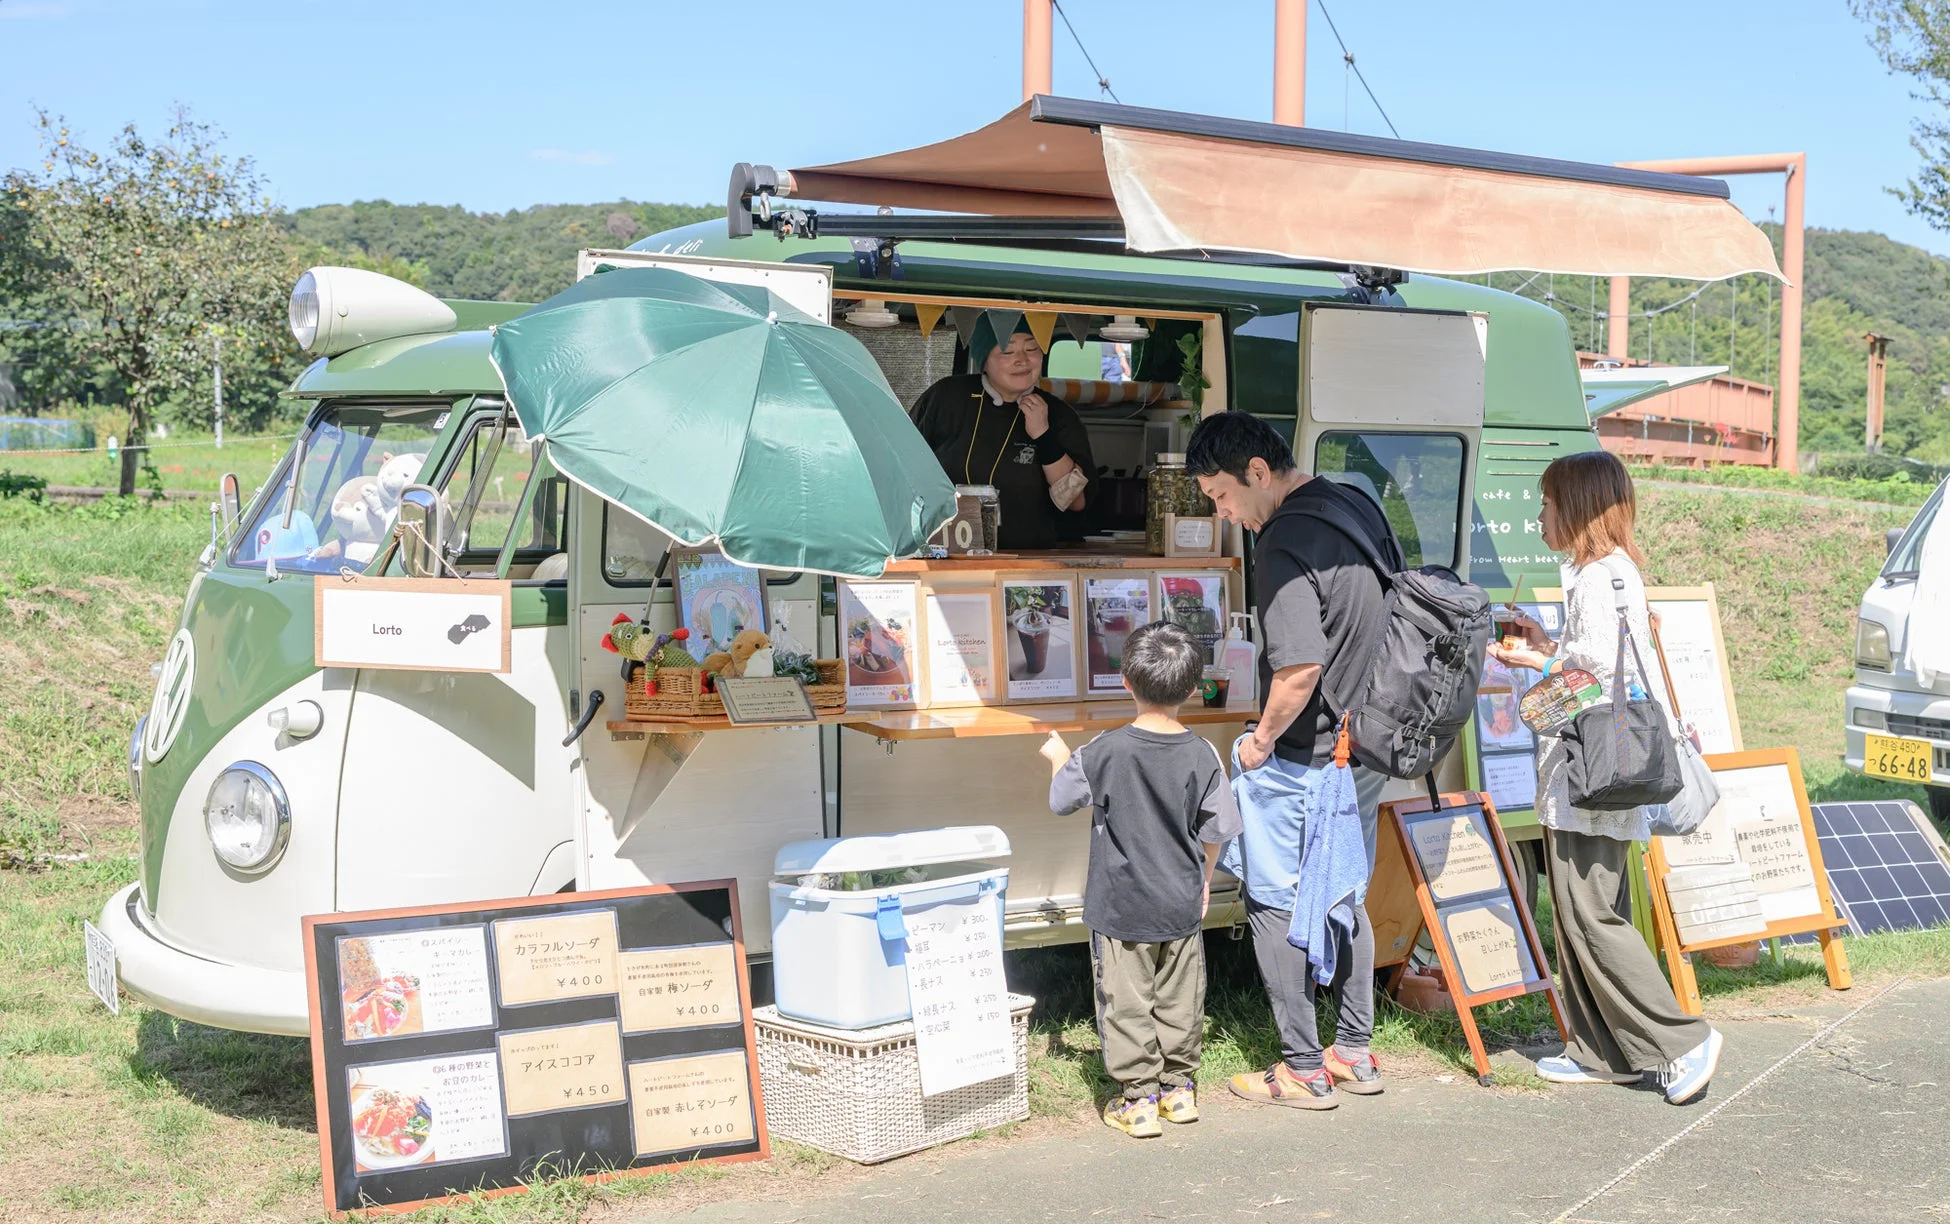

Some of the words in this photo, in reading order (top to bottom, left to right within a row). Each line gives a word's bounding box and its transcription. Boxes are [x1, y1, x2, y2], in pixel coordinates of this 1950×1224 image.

[673, 239, 703, 255] deli
[1483, 489, 1511, 500] cafe
[1523, 490, 1531, 500] &
[1453, 520, 1510, 534] rto
[1535, 555, 1558, 563] beat
[372, 624, 402, 635] Lorto
[1900, 743, 1916, 753] 480
[1880, 754, 1926, 778] 66-48
[1737, 824, 1800, 841] 農薬や化学肥料不使用で
[1751, 838, 1791, 853] 栽培をしている
[1749, 851, 1804, 866] ートビートファーム
[1691, 895, 1747, 924] OPEN
[912, 921, 946, 936] ピーマン
[1456, 926, 1501, 944] お野菜たくさん
[514, 936, 601, 956] カラフルソーダ
[1480, 940, 1512, 954] 召し上がれ
[916, 955, 965, 971] ハラペーニョ
[557, 974, 603, 988] ¥400
[920, 976, 944, 990] 長ナス
[1488, 970, 1506, 982] Lorto
[638, 986, 663, 997] 自家製
[667, 979, 714, 994] 梅ソーダ
[676, 1004, 720, 1017] ¥400
[521, 1053, 596, 1072] アイスココア
[442, 1073, 495, 1086] お豆のカレー
[563, 1083, 610, 1099] ¥450
[645, 1105, 671, 1117] 自家製
[674, 1095, 738, 1113] 赤しそソーダ
[690, 1122, 734, 1136] ¥400
